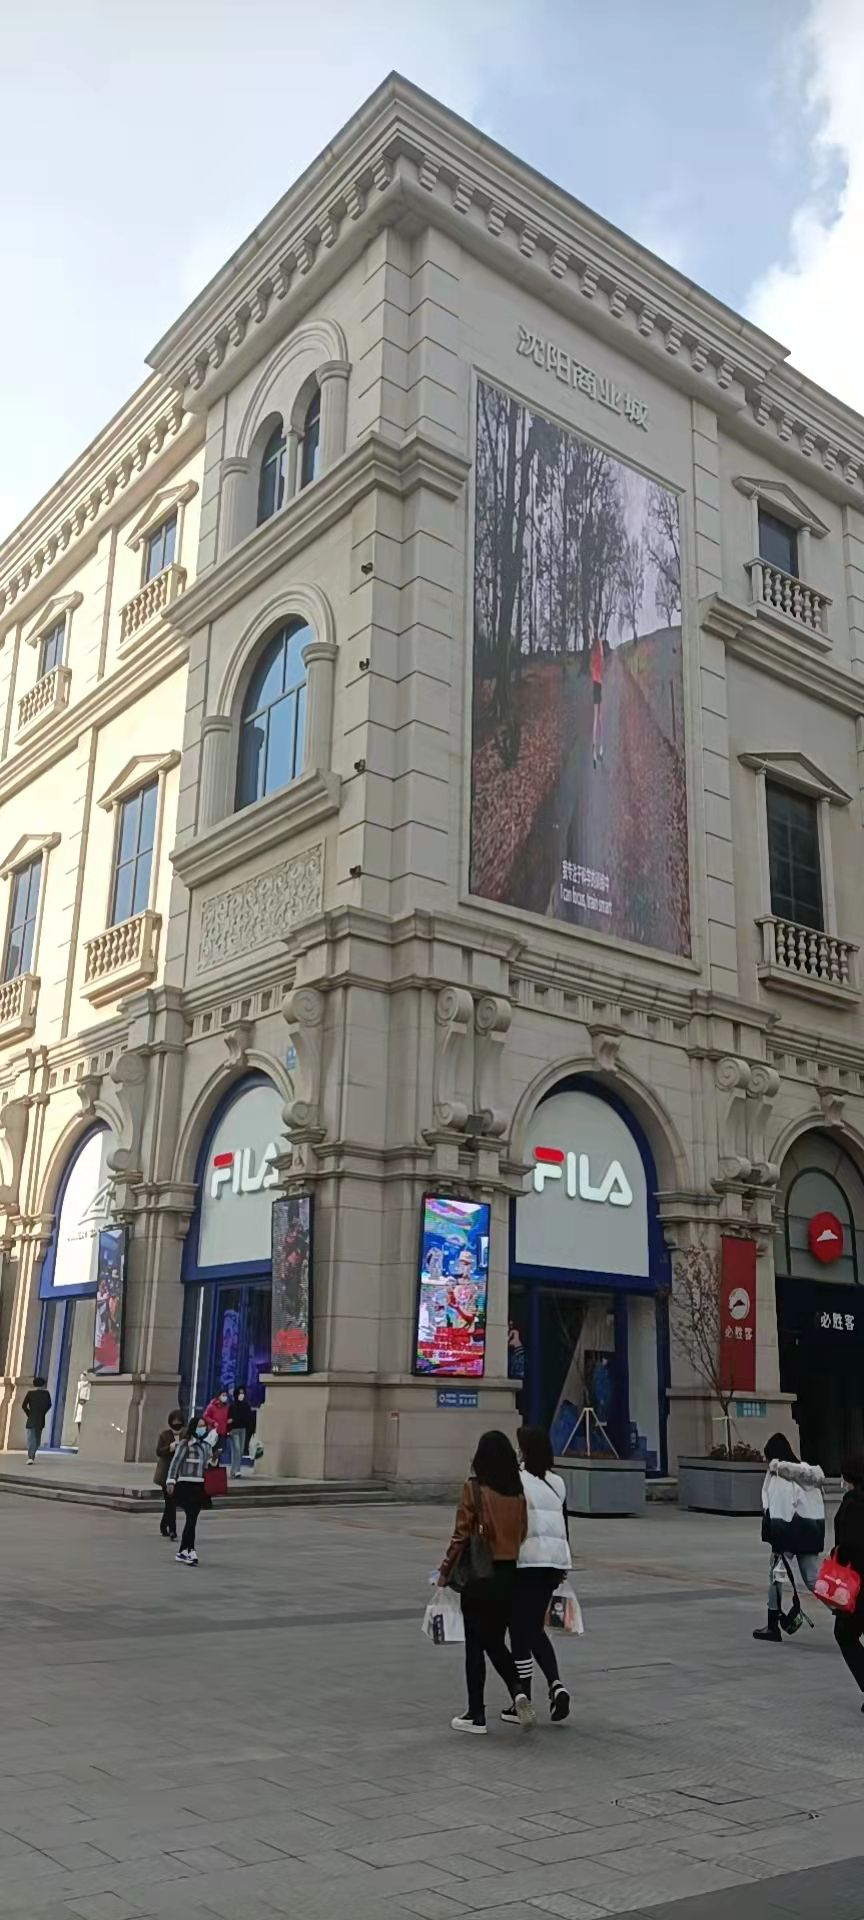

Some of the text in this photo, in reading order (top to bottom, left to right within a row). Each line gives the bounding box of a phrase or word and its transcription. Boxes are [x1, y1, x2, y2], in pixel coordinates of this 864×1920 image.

[516, 324, 649, 432] 沈阳商业城
[211, 1142, 279, 1198] FILA
[533, 1145, 633, 1207] FILA
[725, 1325, 753, 1341] 必胜客
[820, 1312, 855, 1331] 必胜客
